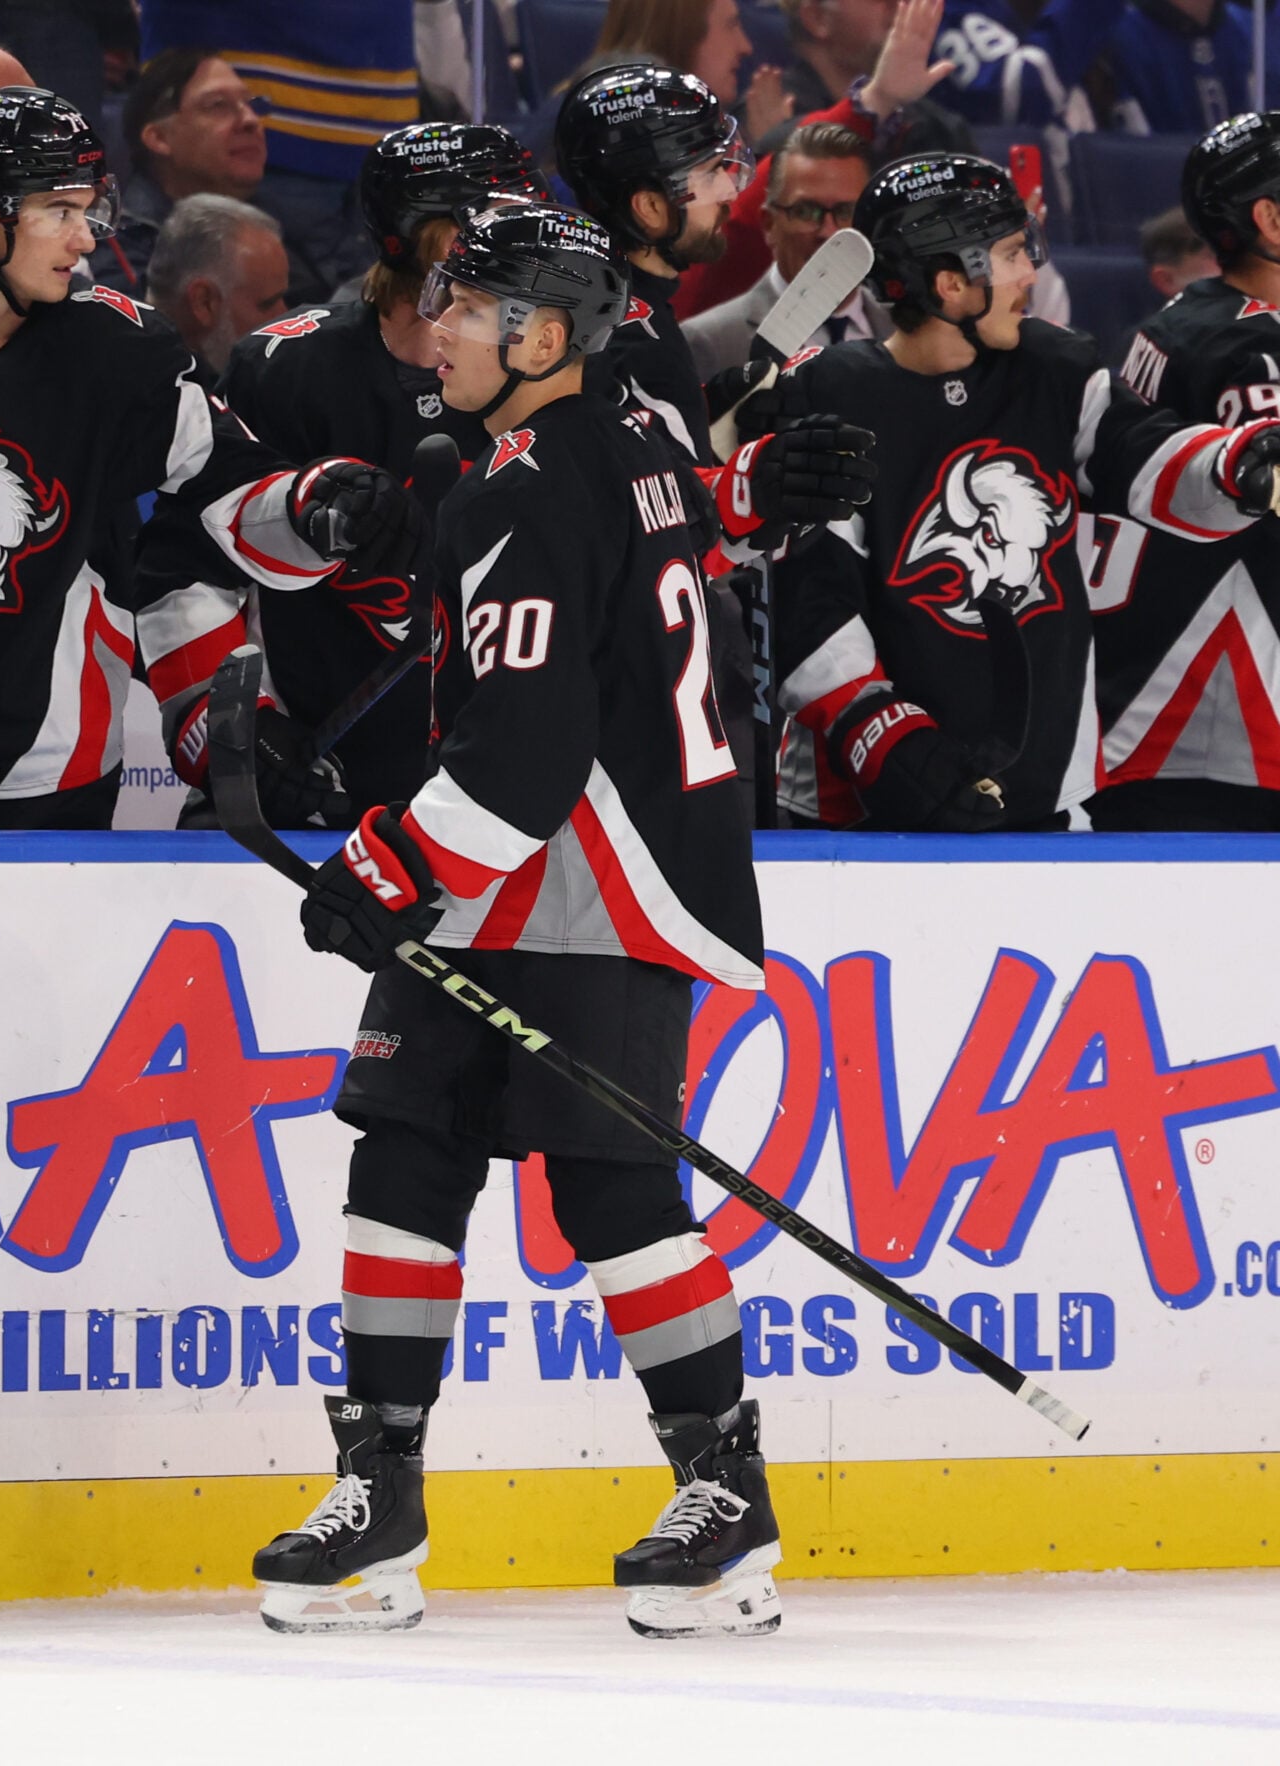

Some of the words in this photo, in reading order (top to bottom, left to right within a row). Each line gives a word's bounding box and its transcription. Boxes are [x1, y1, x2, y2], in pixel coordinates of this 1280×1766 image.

[588, 89, 656, 116] Trusted
[606, 109, 643, 126] talent
[393, 137, 463, 156] Trusted
[409, 152, 450, 166] talent
[888, 166, 955, 195] Trusted
[907, 184, 946, 202] talent
[545, 218, 610, 249] Trusted
[468, 597, 554, 682] 20
[655, 557, 739, 792] 2
[849, 701, 929, 775] BAUE
[345, 826, 404, 901] CM
[395, 940, 552, 1053] CCM
[458, 948, 1280, 1311] OVA
[662, 1134, 824, 1247] JETSPEED
[440, 1300, 508, 1382] F
[531, 1299, 858, 1379] WGS
[885, 1292, 1116, 1377] SOLD
[341, 1404, 363, 1420] 20
